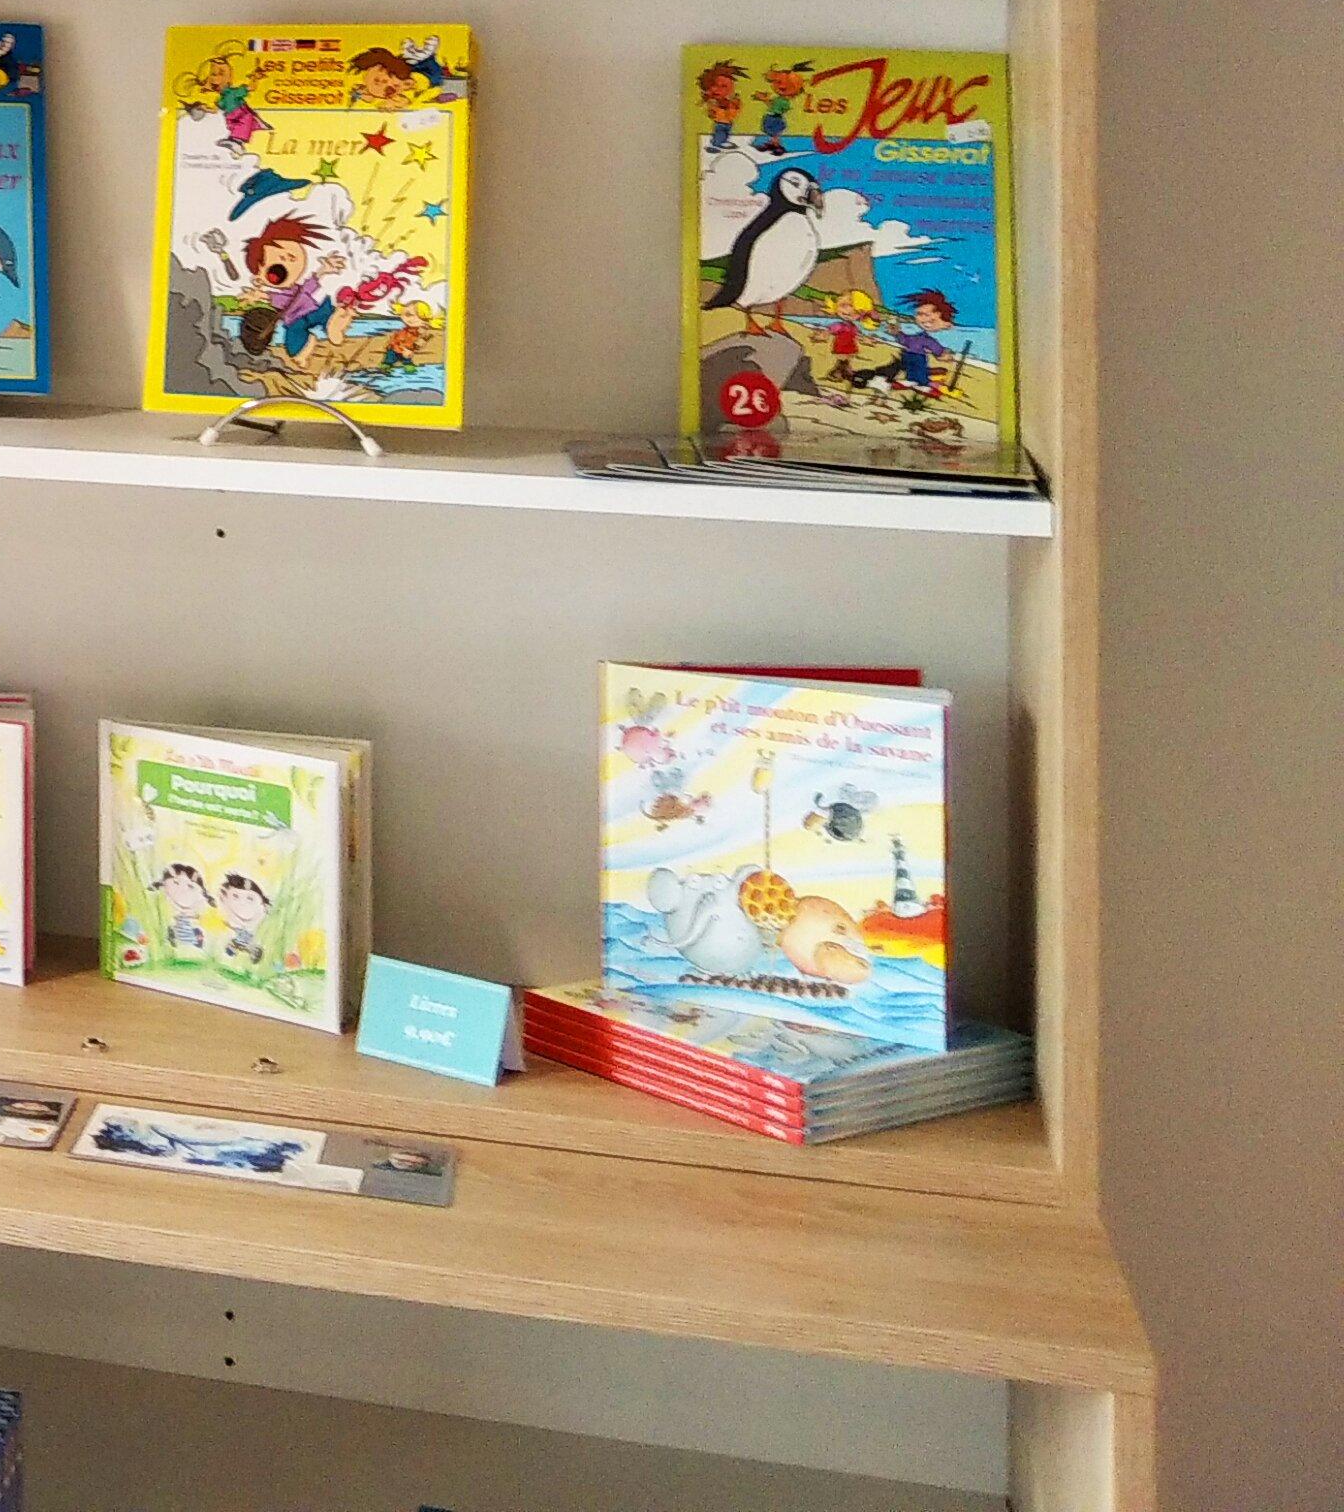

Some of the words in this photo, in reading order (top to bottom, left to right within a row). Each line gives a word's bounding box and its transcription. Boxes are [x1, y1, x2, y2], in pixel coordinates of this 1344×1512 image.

[291, 57, 345, 74] petits
[264, 89, 344, 104] Gisserot
[803, 92, 848, 115] Les
[811, 57, 991, 154] Jeux
[266, 131, 297, 155] La
[307, 139, 363, 155] mer
[874, 140, 991, 165] Gisserot
[728, 384, 769, 416] 2€
[170, 773, 257, 802] Pourquoi
